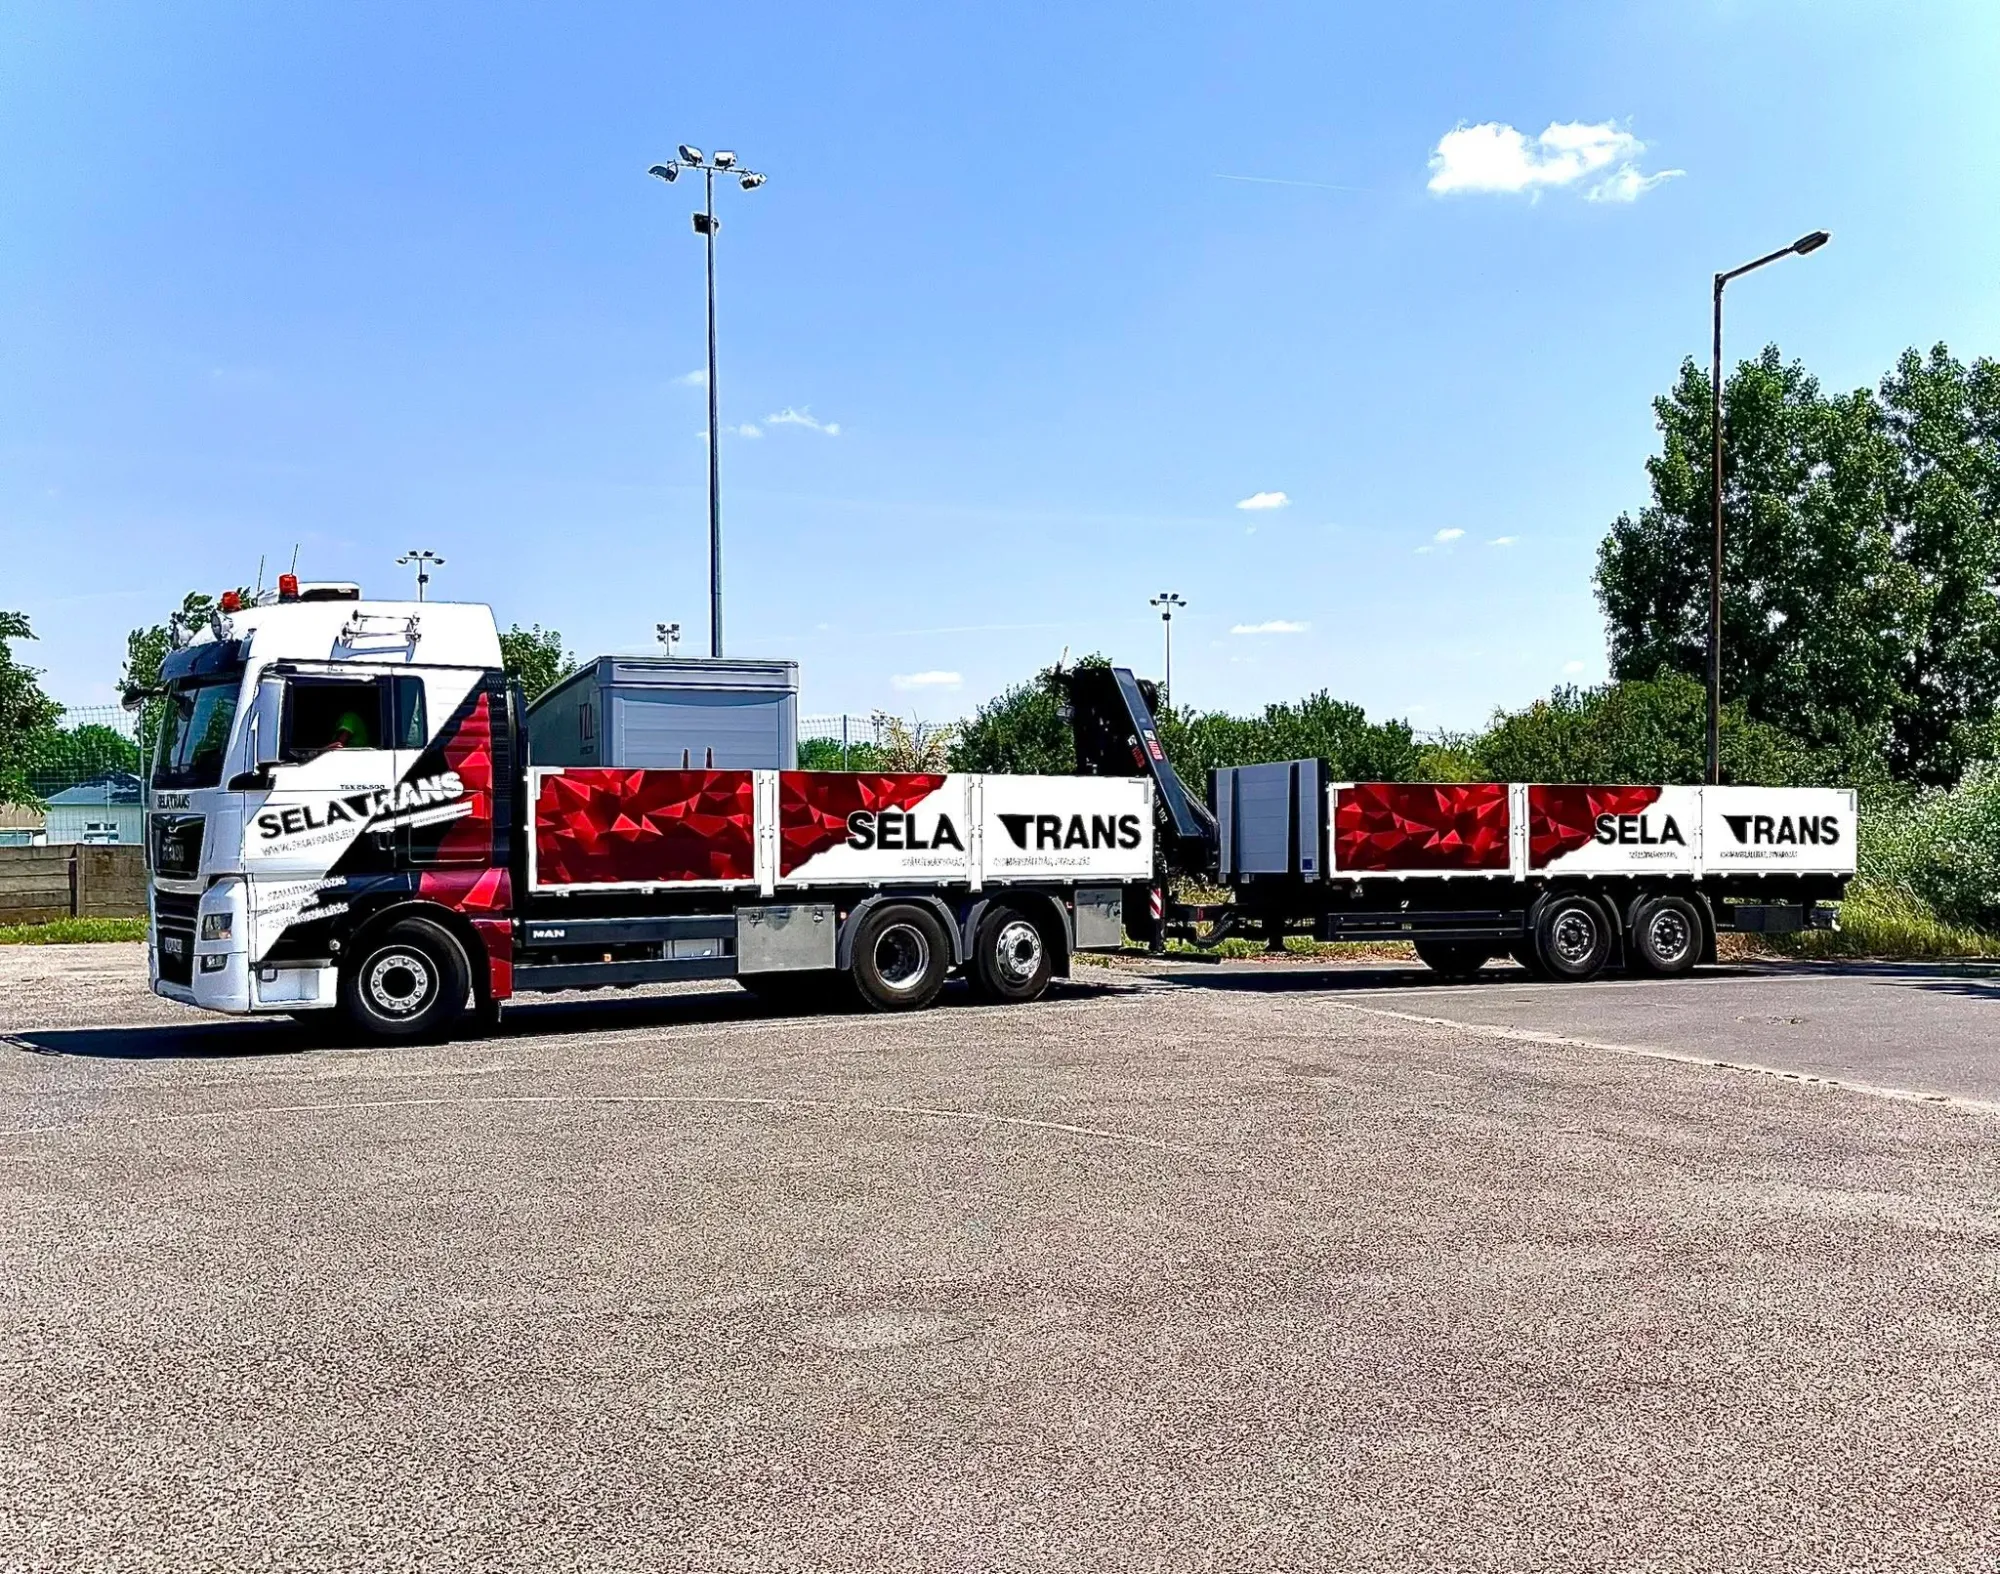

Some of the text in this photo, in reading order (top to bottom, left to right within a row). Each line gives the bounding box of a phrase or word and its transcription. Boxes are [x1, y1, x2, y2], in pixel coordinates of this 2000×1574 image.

[846, 810, 1142, 851] SELA TRANS
[1595, 813, 1841, 846] SELA TRANS
[533, 929, 565, 938] MAN
